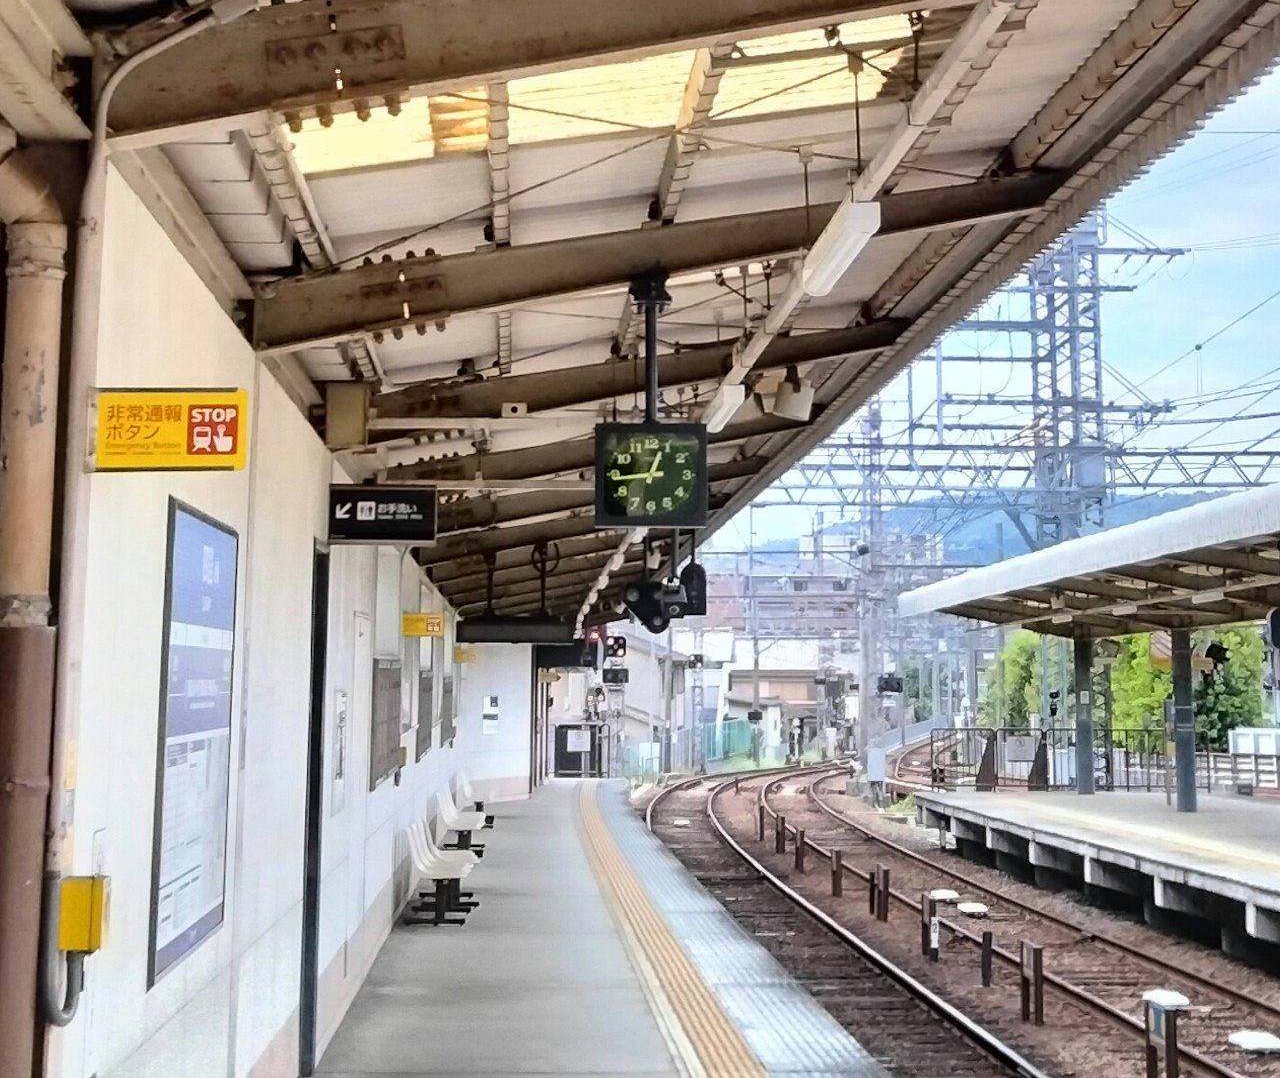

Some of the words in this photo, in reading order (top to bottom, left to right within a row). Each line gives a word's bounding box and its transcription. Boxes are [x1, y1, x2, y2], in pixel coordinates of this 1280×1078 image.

[106, 404, 182, 422] 非常通報
[191, 408, 237, 423] STOP
[106, 424, 160, 440] ボタン
[629, 443, 642, 453] 11
[644, 438, 660, 450] 12
[664, 441, 671, 453] 1
[616, 453, 632, 465] 10
[675, 452, 686, 464] 2
[682, 469, 692, 481] 3
[617, 485, 628, 497] 8
[673, 485, 685, 497] 4
[630, 497, 641, 510] 7
[645, 500, 657, 512] 6
[662, 496, 673, 508] 5
